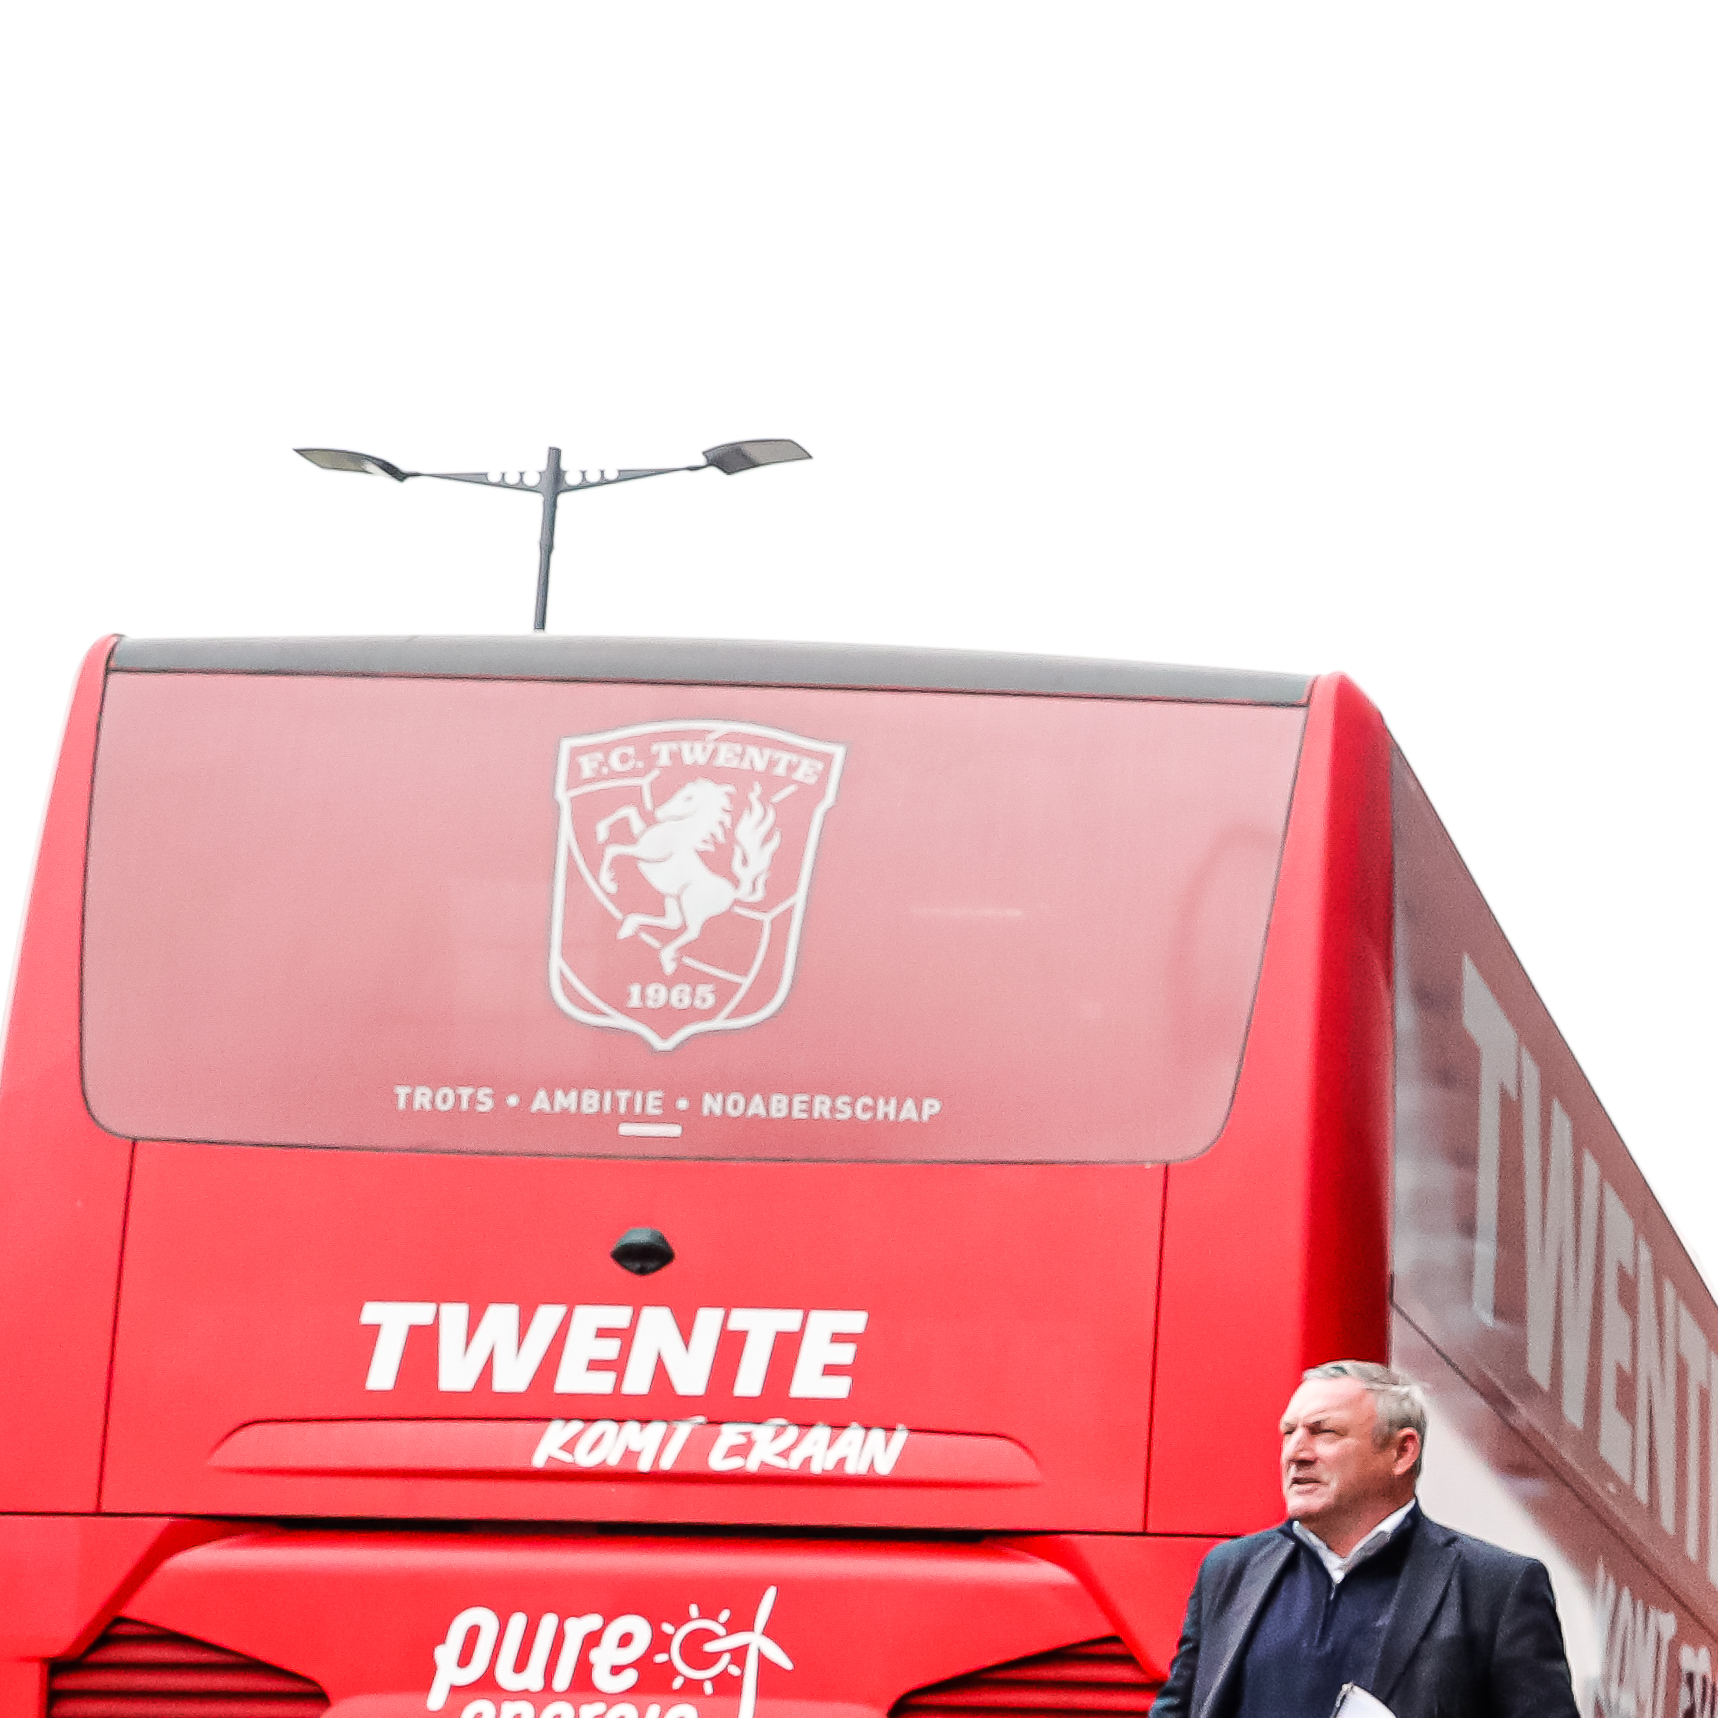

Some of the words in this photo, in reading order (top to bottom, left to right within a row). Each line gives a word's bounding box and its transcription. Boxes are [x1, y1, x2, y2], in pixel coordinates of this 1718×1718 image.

[578, 745, 645, 779] F.C.
[651, 740, 825, 786] TWENTE
[626, 982, 717, 1010] 1965
[394, 1085, 494, 1113] TROTS
[530, 1089, 665, 1116] AMBITIE
[701, 1092, 943, 1122] NOABERSCHAP
[359, 1301, 869, 1399] TWENTE
[531, 1415, 705, 1474] KOMT
[427, 1606, 652, 1712] pure
